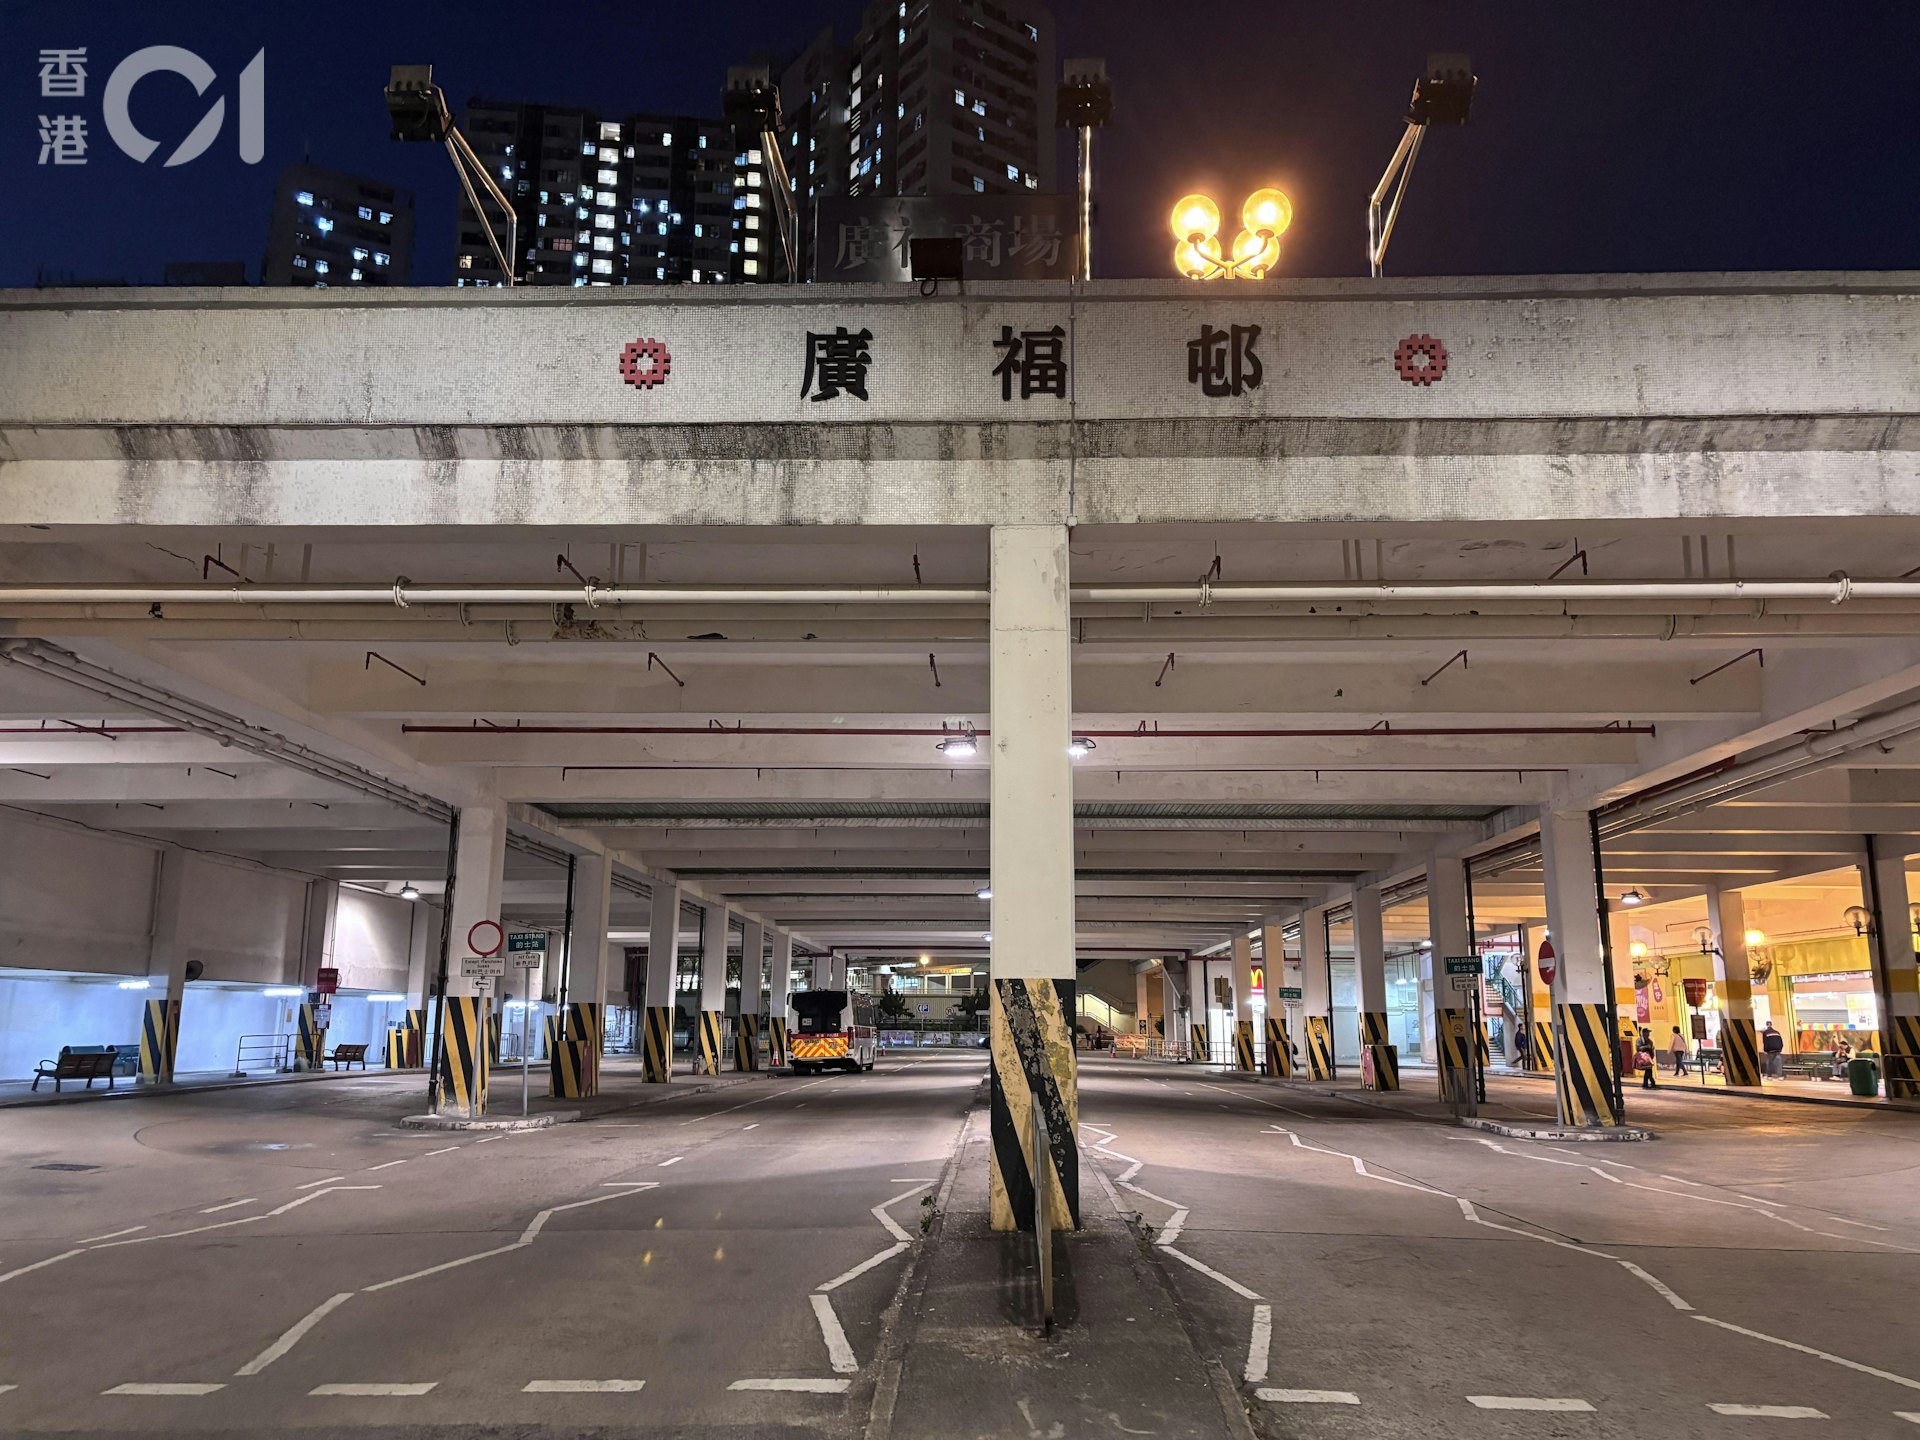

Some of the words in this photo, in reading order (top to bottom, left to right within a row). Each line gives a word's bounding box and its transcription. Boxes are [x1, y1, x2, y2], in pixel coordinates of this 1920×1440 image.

[800, 325, 1263, 401] 廣福邨
[515, 941, 539, 949] 的士站
[1453, 964, 1476, 972] 的士站
